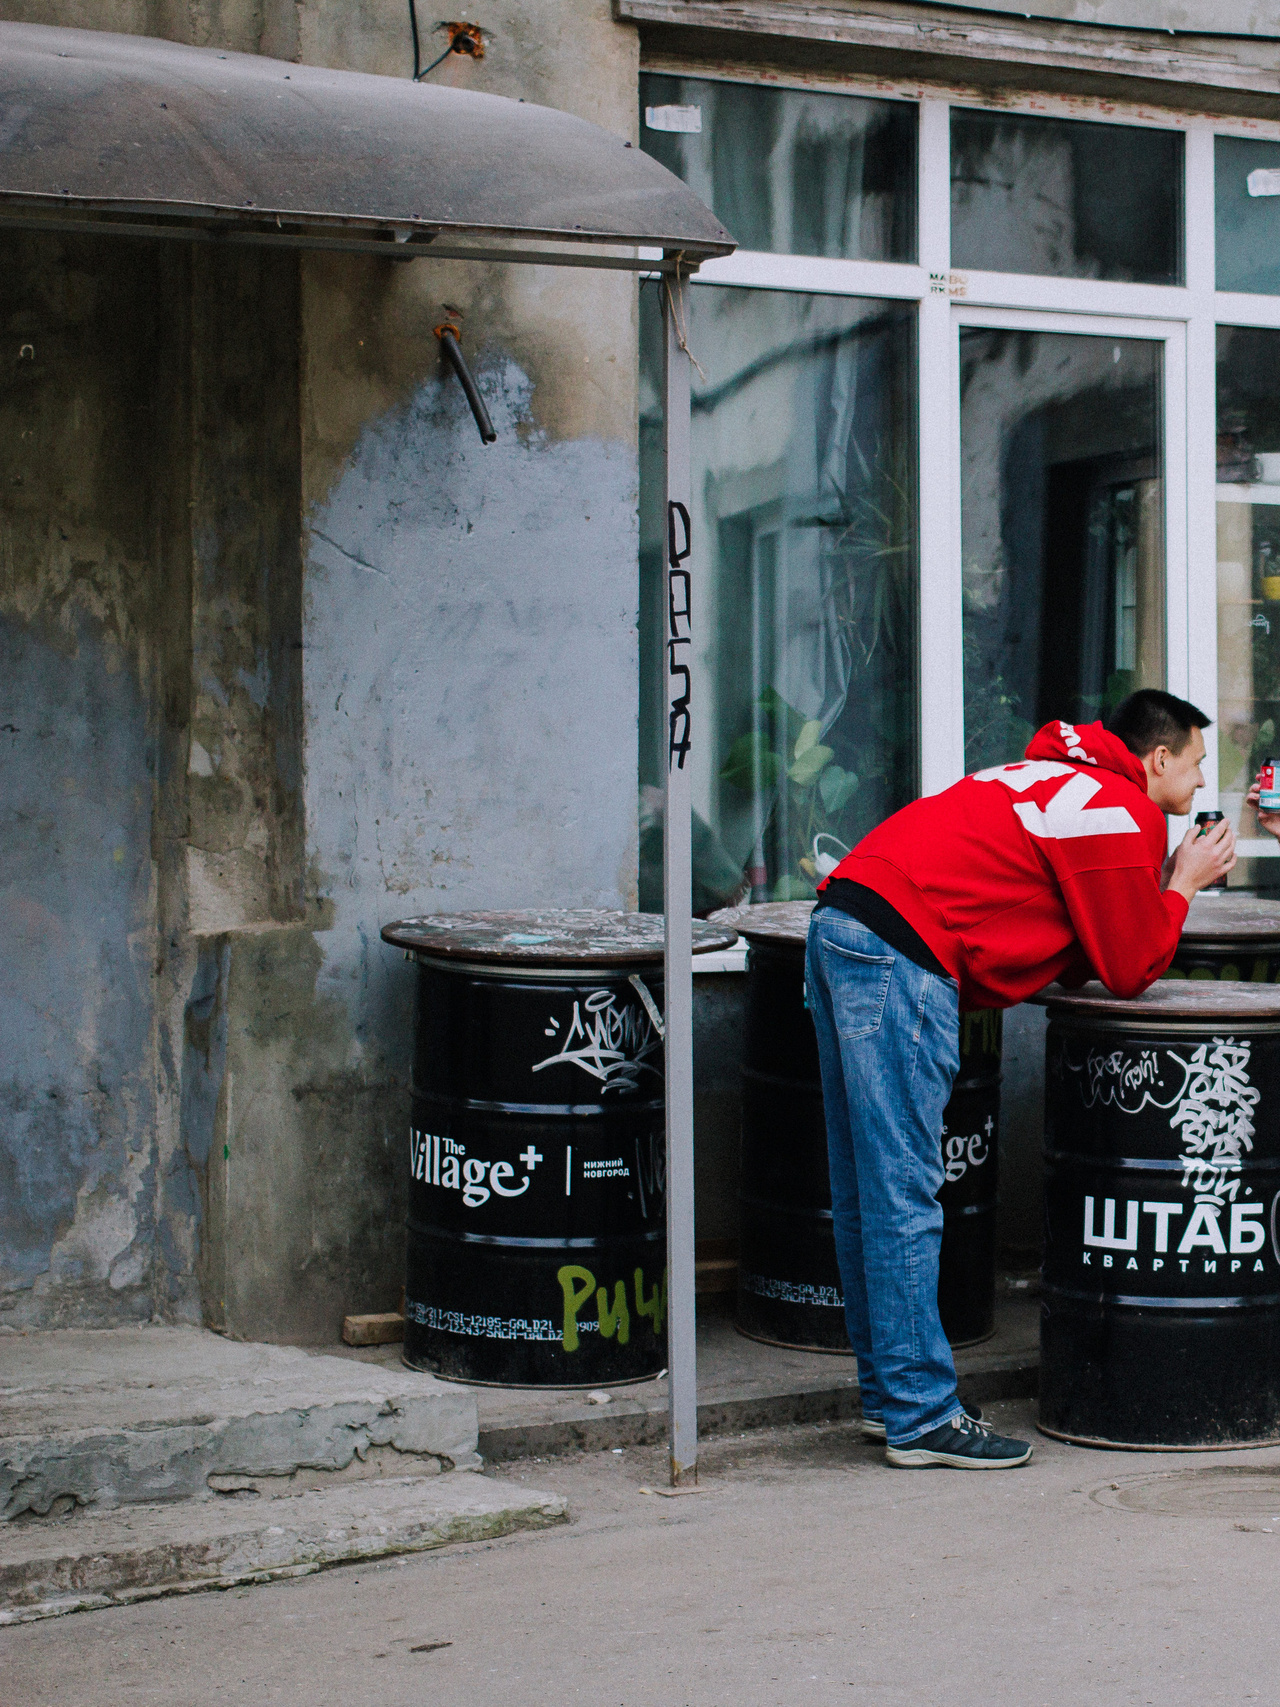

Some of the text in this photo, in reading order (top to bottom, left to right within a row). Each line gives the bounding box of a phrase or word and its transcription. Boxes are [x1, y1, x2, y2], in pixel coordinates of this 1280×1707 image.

[442, 1138, 466, 1155] The
[584, 1158, 623, 1169] НИЖНИЙ
[584, 1168, 630, 1178] НОВГОРОД
[1084, 1196, 1266, 1254] ШТАБ
[1083, 1252, 1264, 1274] КВАРТИРА
